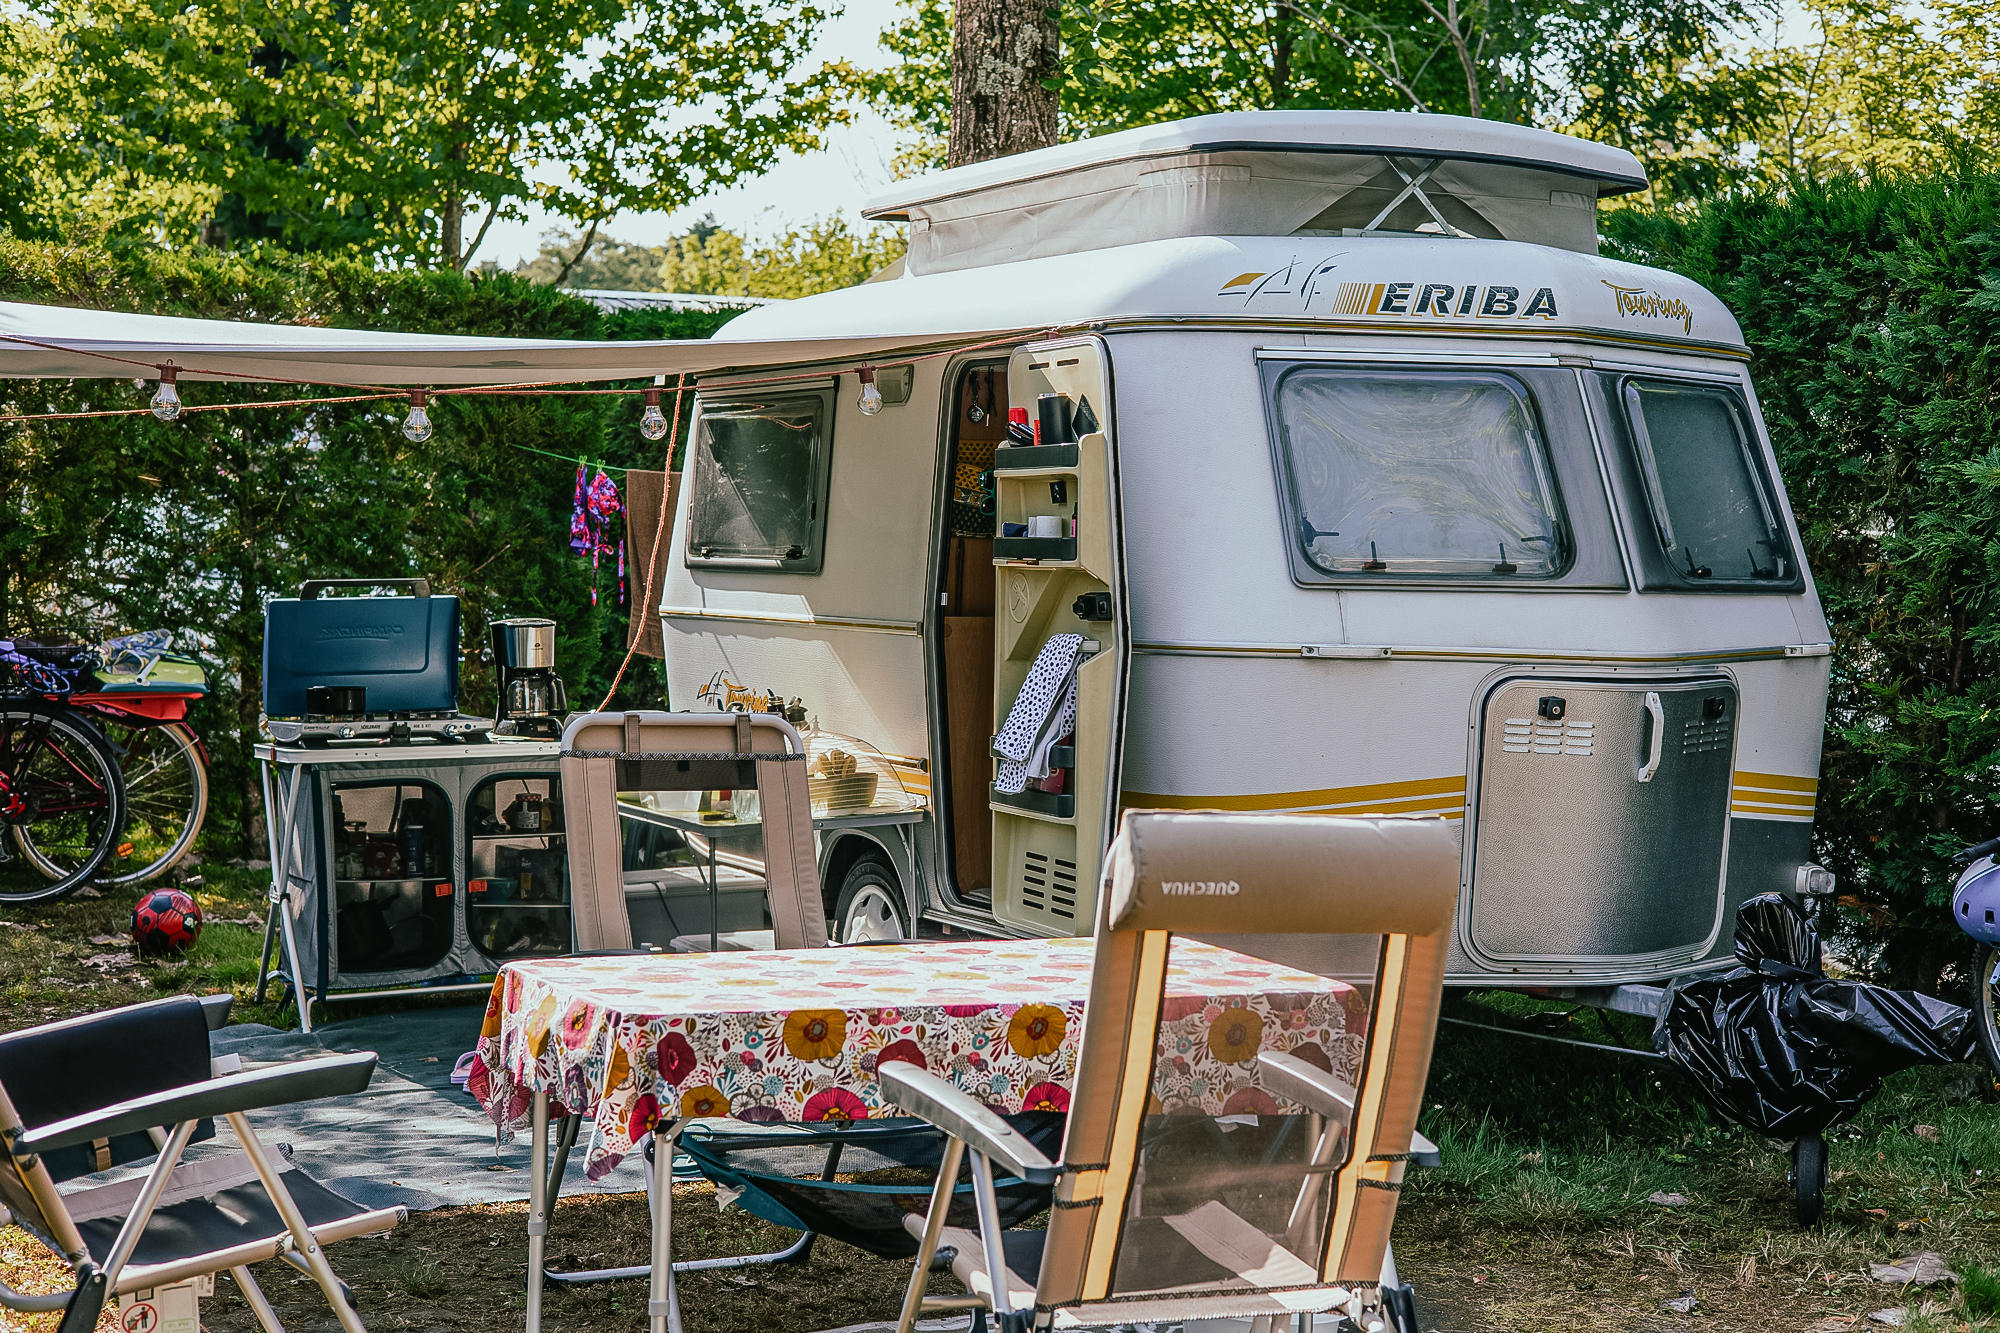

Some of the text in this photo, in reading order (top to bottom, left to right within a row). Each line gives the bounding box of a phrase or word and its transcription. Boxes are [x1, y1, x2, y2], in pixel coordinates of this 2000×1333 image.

[1375, 282, 1560, 319] ERIBA
[1601, 280, 1693, 335] Touring
[1161, 880, 1240, 896] QUECHUA
